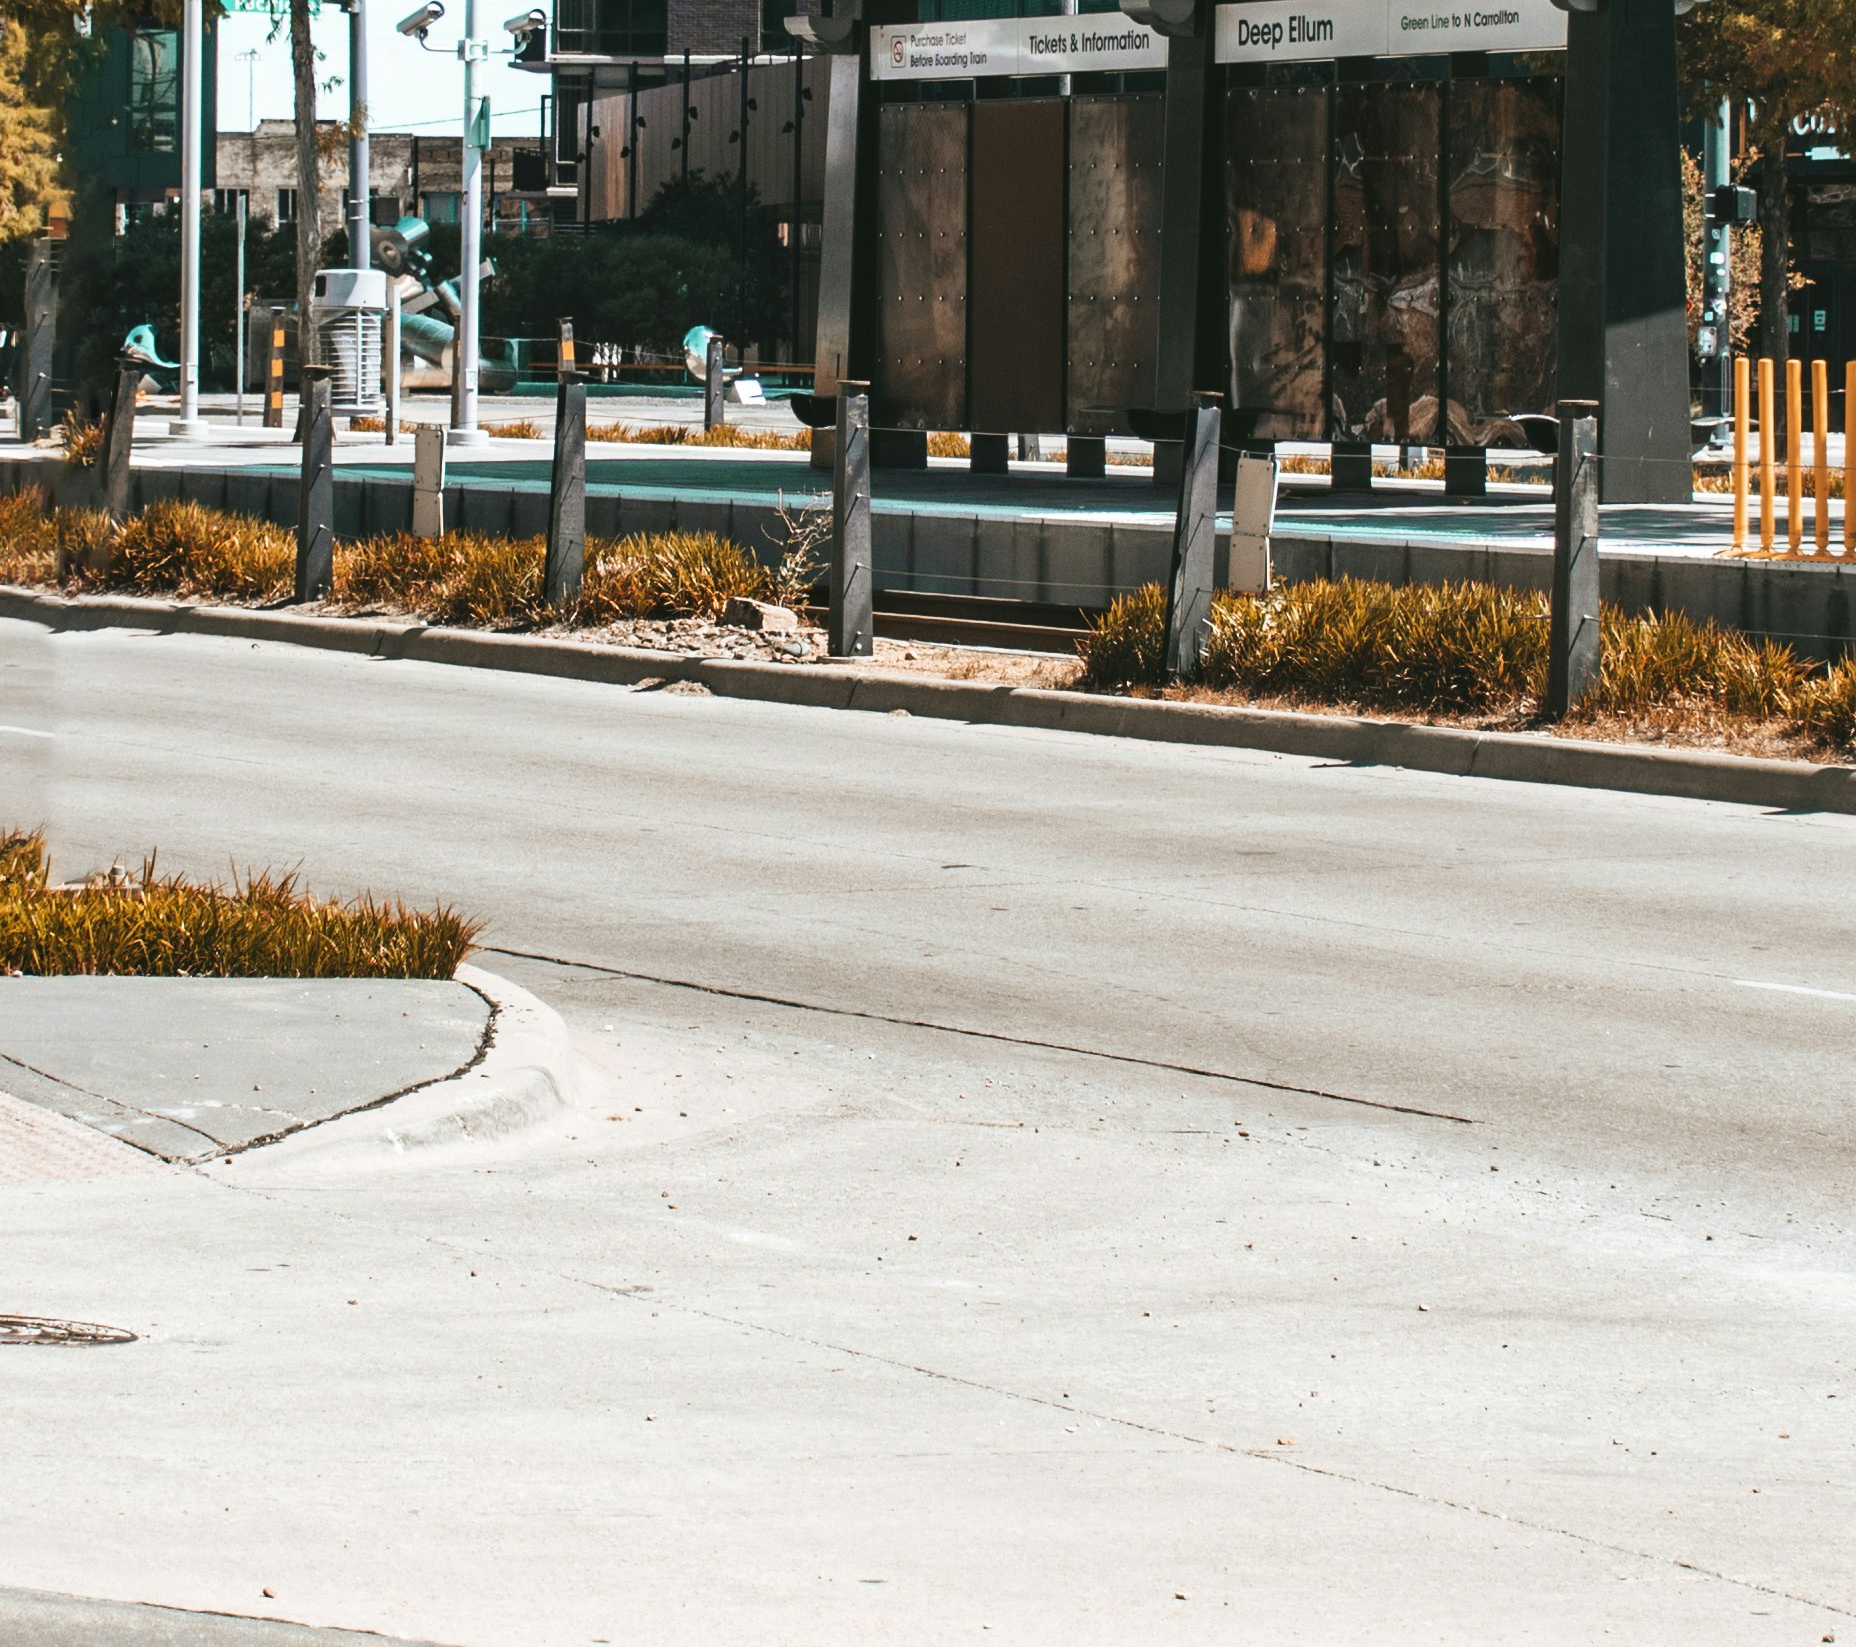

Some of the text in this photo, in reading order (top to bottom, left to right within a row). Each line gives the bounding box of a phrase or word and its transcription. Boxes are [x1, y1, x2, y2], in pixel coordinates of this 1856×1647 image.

[1400, 10, 1519, 30] Green Line to N Carrollton
[910, 32, 967, 47] Purchase Ticket
[1029, 30, 1150, 54] Tickets & Information
[1238, 15, 1333, 50] Deep Ellum
[910, 51, 988, 69] Before Boarding Train
